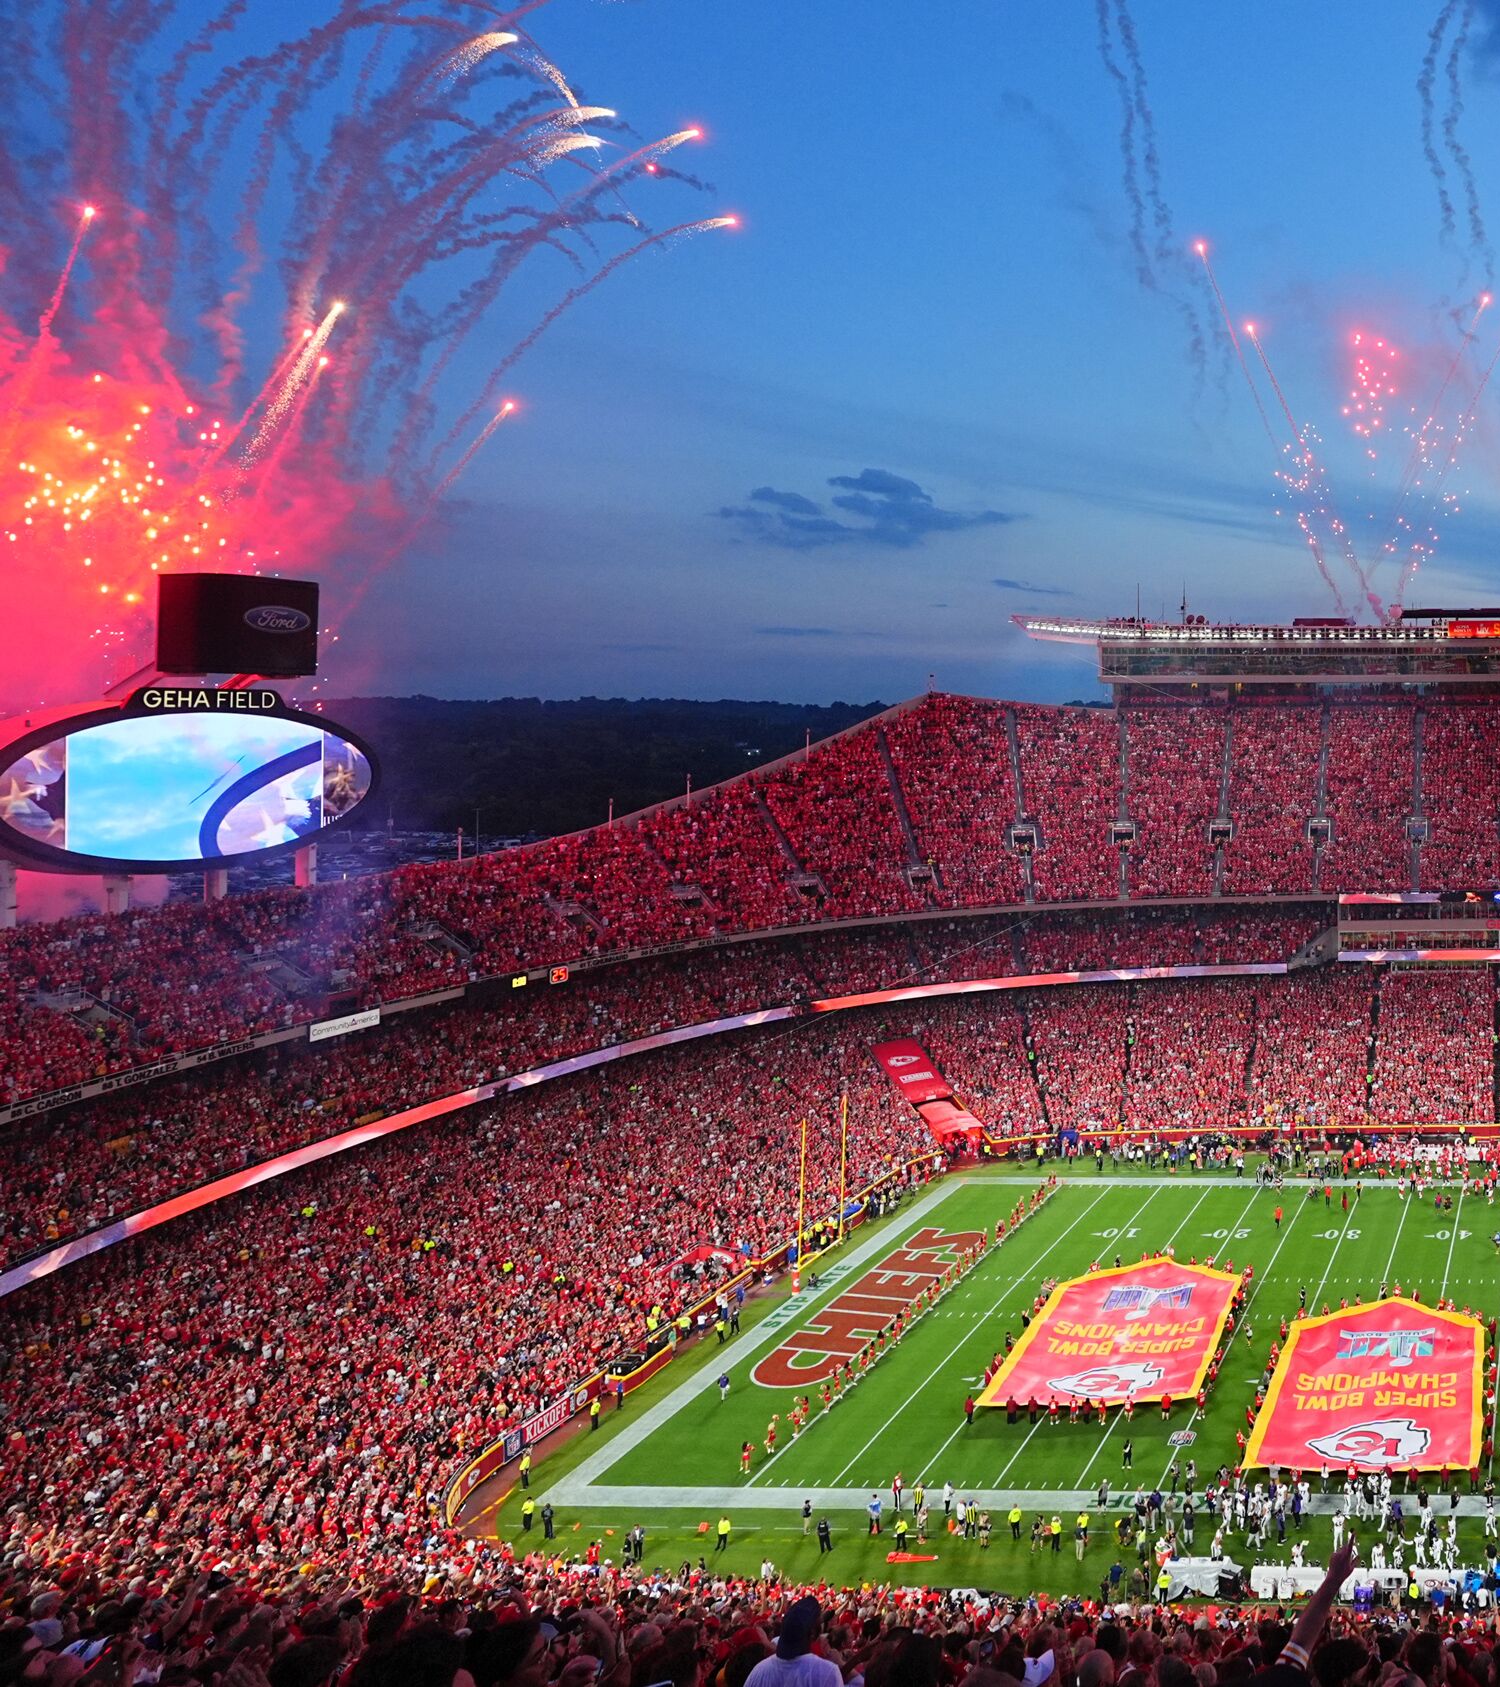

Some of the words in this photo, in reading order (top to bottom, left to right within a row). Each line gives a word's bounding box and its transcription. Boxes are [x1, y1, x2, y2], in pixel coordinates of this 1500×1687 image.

[258, 608, 298, 629] Ford
[143, 690, 210, 708] GEHA
[216, 691, 276, 709] FIELD
[552, 968, 566, 982] 25
[217, 1041, 255, 1058] WATERS
[124, 1062, 179, 1084] GONZALEZ
[37, 1090, 82, 1112] CARSON
[749, 1227, 987, 1389] CHIEFS
[761, 1296, 808, 1330] STOP
[1053, 1316, 1206, 1340] CHAMPIONS
[1047, 1336, 1116, 1356] BOWL
[1118, 1336, 1200, 1354] SUPER
[1296, 1372, 1458, 1392] CHAMPIONS
[1293, 1390, 1364, 1411] BOWL
[1374, 1390, 1457, 1408] SUPER
[526, 1400, 568, 1442] KICKOFF
